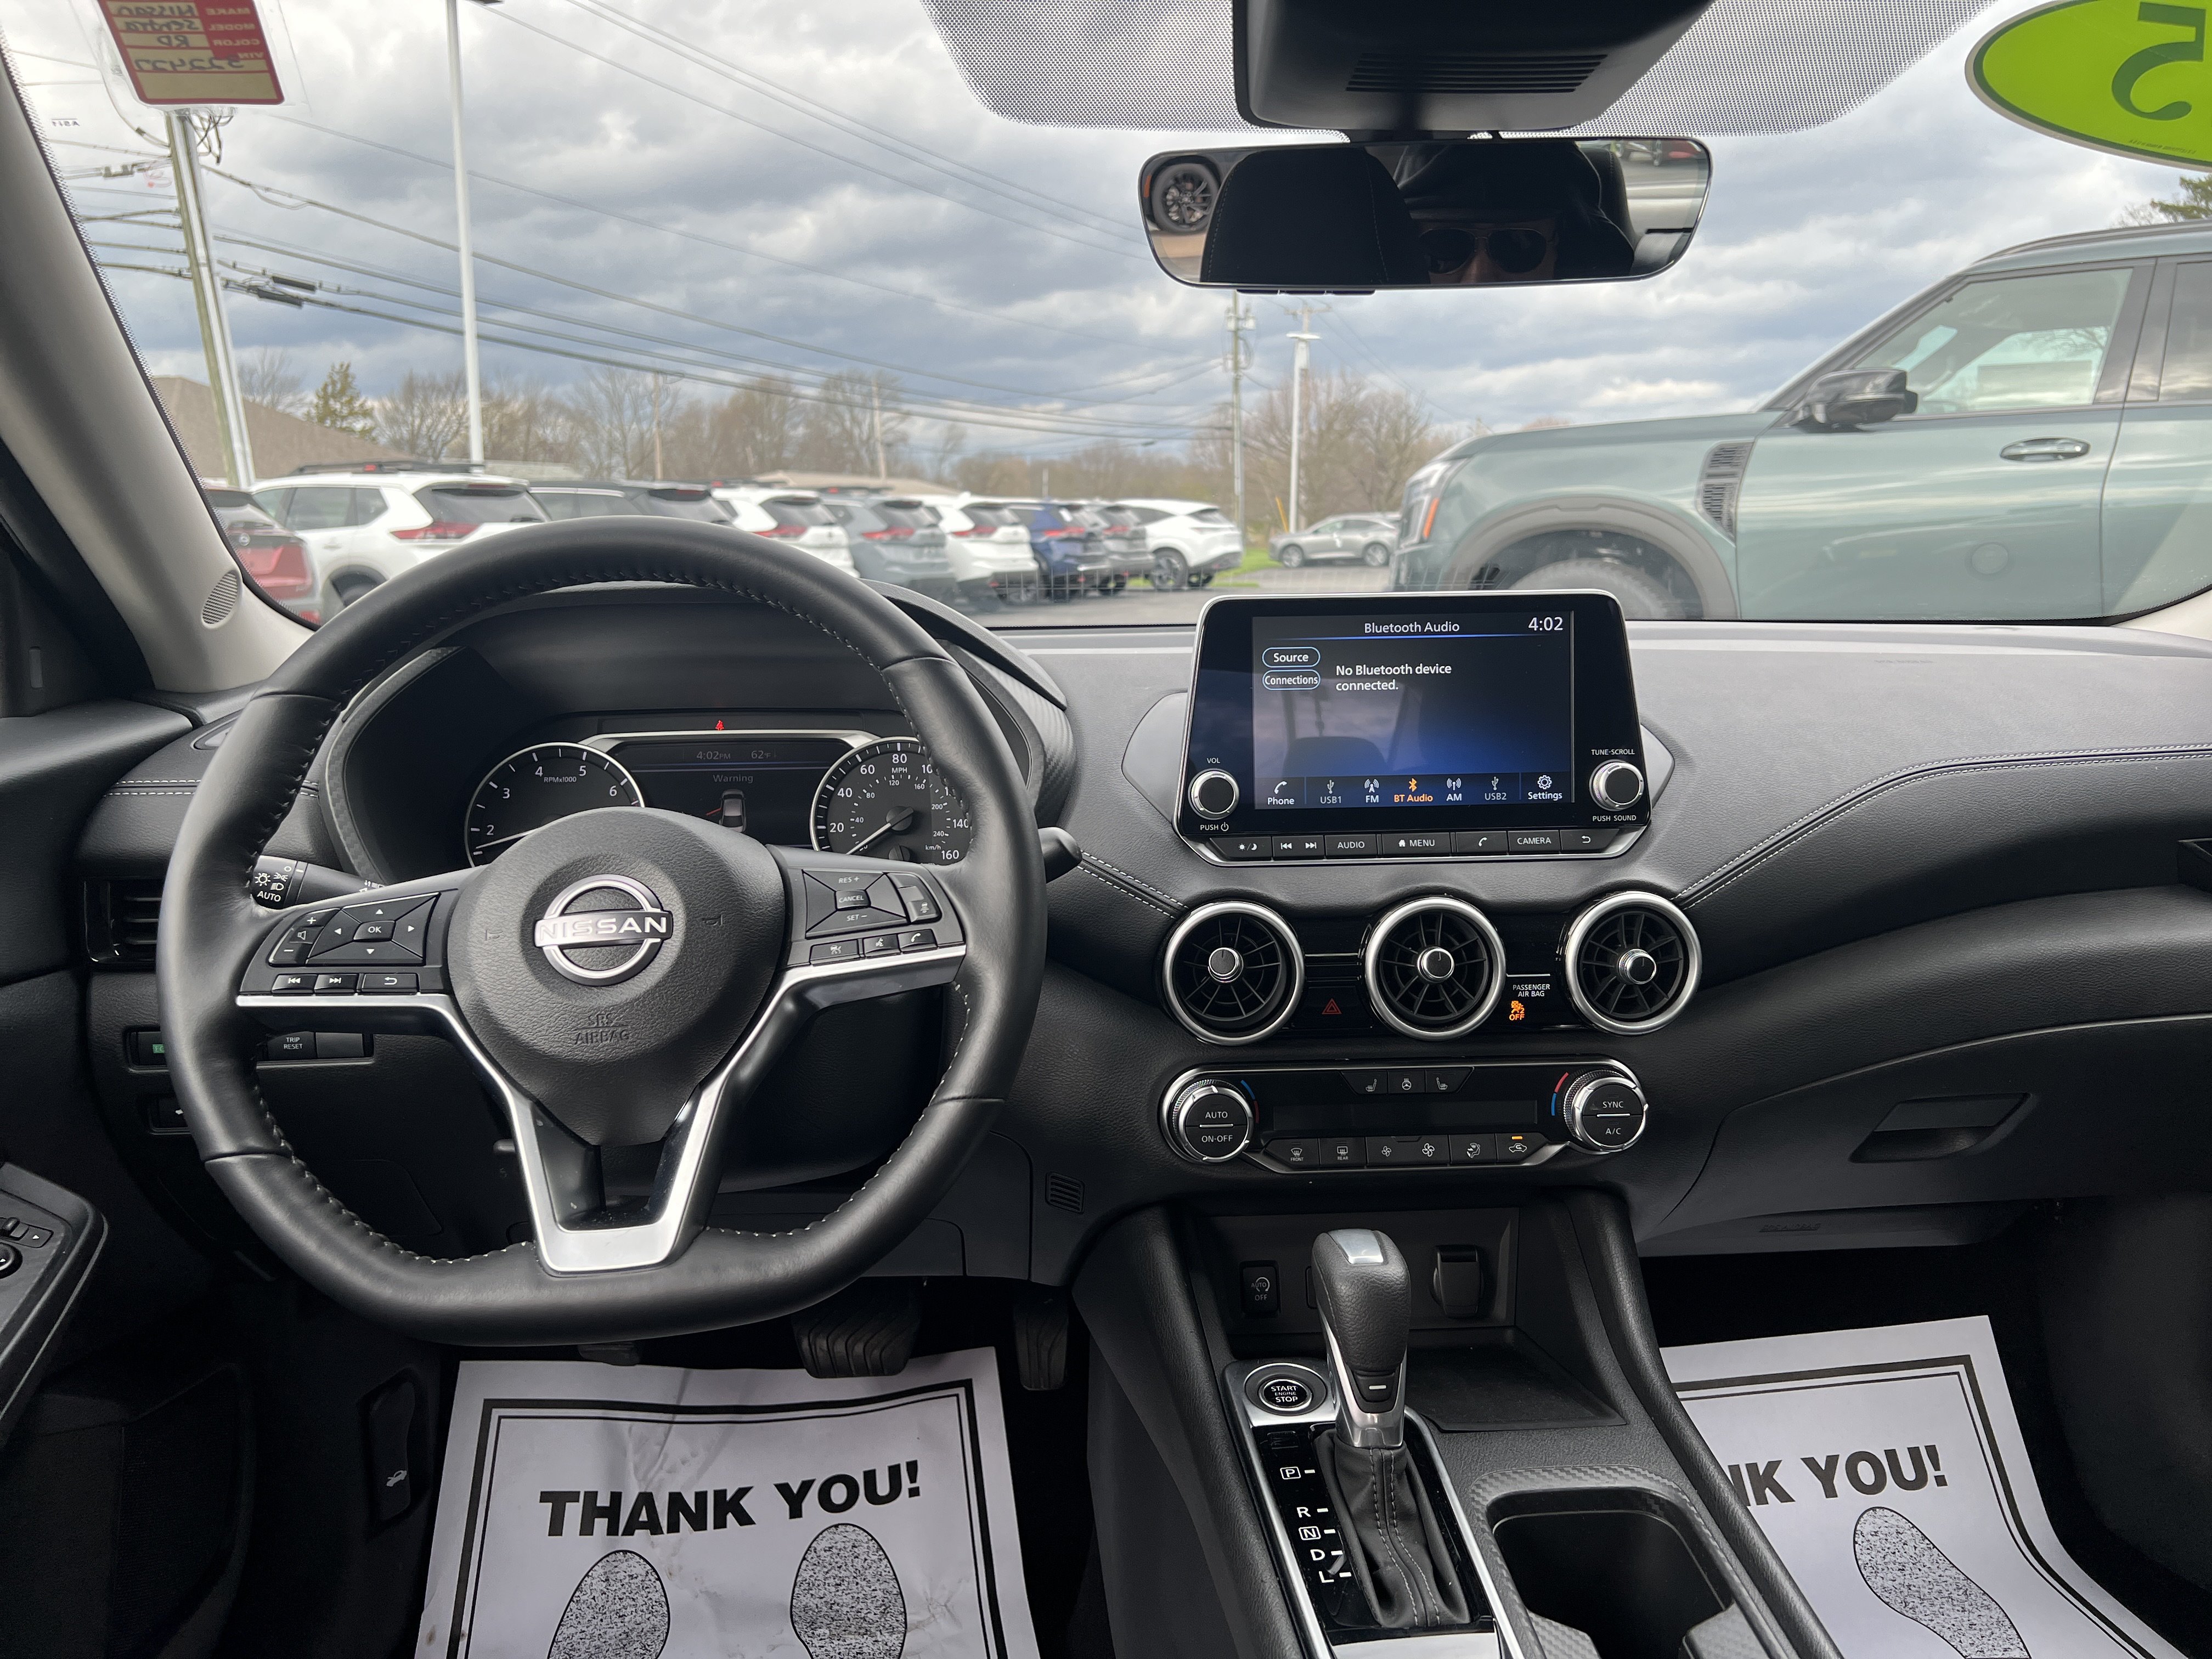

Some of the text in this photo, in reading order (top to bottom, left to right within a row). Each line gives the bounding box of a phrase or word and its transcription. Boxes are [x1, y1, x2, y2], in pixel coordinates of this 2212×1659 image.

[1364, 621, 1460, 633] Bluetooth Audio
[1528, 617, 1564, 631] 4:02
[1273, 652, 1309, 663] Source
[1336, 663, 1452, 676] No Bluetooth device
[1265, 675, 1318, 685] Connections
[1335, 679, 1399, 691] connected.
[892, 754, 907, 764] 80
[535, 766, 544, 777] 4
[579, 765, 586, 777] 5
[860, 764, 875, 775] 60
[713, 774, 753, 783] Warning
[502, 788, 510, 799] 3
[609, 785, 617, 797] 6
[837, 787, 853, 798] 40
[1485, 792, 1507, 801] USB2
[1527, 791, 1562, 801] Settings
[1267, 797, 1295, 805] Phone
[1320, 796, 1342, 804] USB1
[1365, 795, 1379, 803] FM
[1394, 794, 1433, 803] BT Audio
[1446, 793, 1462, 802] AM
[486, 825, 494, 836] 2
[830, 822, 844, 833] 20
[1337, 841, 1365, 849] AUDIO
[1409, 839, 1435, 847] MENU
[1517, 837, 1551, 845] CAMERA
[941, 850, 960, 860] 160
[257, 890, 281, 902] AUTO
[539, 917, 667, 941] NISSAN
[588, 1014, 614, 1027] SRS
[575, 1029, 629, 1045] AIRBAG
[1285, 1469, 1295, 1477] P
[1801, 1444, 1948, 1498] YOU!
[539, 1459, 921, 1537] THANK YOU!
[1296, 1507, 1311, 1517] R
[1303, 1528, 1317, 1538] N
[1310, 1549, 1325, 1561] D
[1318, 1571, 1334, 1583] L
